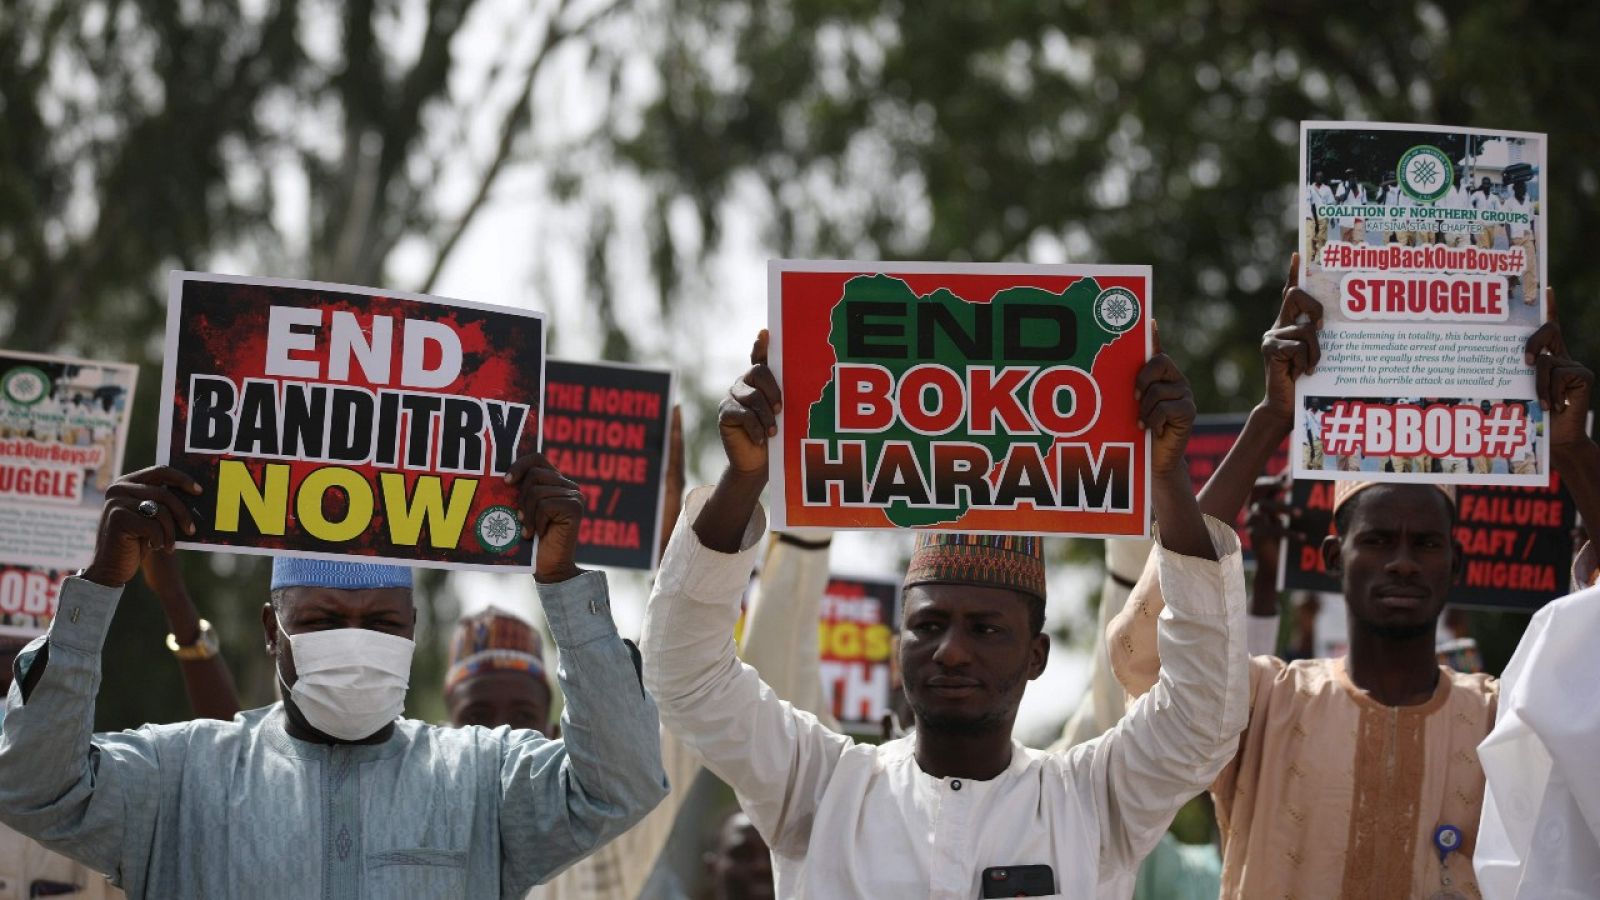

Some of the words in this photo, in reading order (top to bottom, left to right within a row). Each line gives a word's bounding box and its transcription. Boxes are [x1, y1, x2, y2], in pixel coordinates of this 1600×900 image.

[1318, 206, 1386, 217] COALITION
[1389, 207, 1406, 217] OF
[1409, 208, 1478, 220] NORTHERN
[1481, 210, 1529, 224] GROUPS
[1366, 221, 1407, 232] KATSINA
[1408, 222, 1438, 232] STATE
[1440, 223, 1482, 233] CHAPTER
[1323, 244, 1524, 273] #BringBackOurBoys#
[1347, 279, 1503, 315] STRUGGLE
[265, 305, 464, 389] END
[845, 301, 1078, 361] END
[1316, 330, 1337, 340] hile
[1339, 330, 1395, 341] Condemning
[1398, 331, 1406, 340] in
[1445, 331, 1461, 341] this
[1463, 332, 1502, 342] barbaric
[1503, 334, 1516, 342] act
[1328, 342, 1343, 352] for
[1345, 341, 1359, 350] the
[1361, 342, 1408, 351] immediate
[1409, 343, 1437, 351] arrest
[1438, 343, 1456, 352] and
[1457, 344, 1508, 354] prosecution
[1510, 344, 1521, 354] of
[1327, 353, 1363, 363] culprits,
[1380, 353, 1412, 364] equally
[1441, 354, 1456, 362] the
[1457, 354, 1494, 365] inability
[1496, 355, 1506, 366] of
[1507, 355, 1521, 364] the
[1368, 365, 1377, 373] to
[1379, 365, 1410, 375] protect
[1412, 364, 1425, 373] the
[1427, 366, 1456, 376] young
[1457, 365, 1495, 375] innocent
[1334, 375, 1357, 386] from
[1359, 375, 1376, 385] this
[1377, 375, 1413, 385] horrible
[1414, 376, 1443, 385] attack
[1457, 376, 1494, 386] uncalled
[1497, 377, 1511, 388] for
[546, 382, 584, 412] THE
[588, 385, 661, 419] NORTH
[835, 363, 1101, 437] BOKO
[185, 374, 530, 477] BANDITRY
[1322, 403, 1526, 457] #BBOB#
[801, 439, 1135, 513] HARAM
[213, 459, 480, 550] NOW
[1459, 494, 1563, 528] FAILURE
[1452, 526, 1518, 557] RAFT
[1465, 559, 1557, 593] NIGERIA
